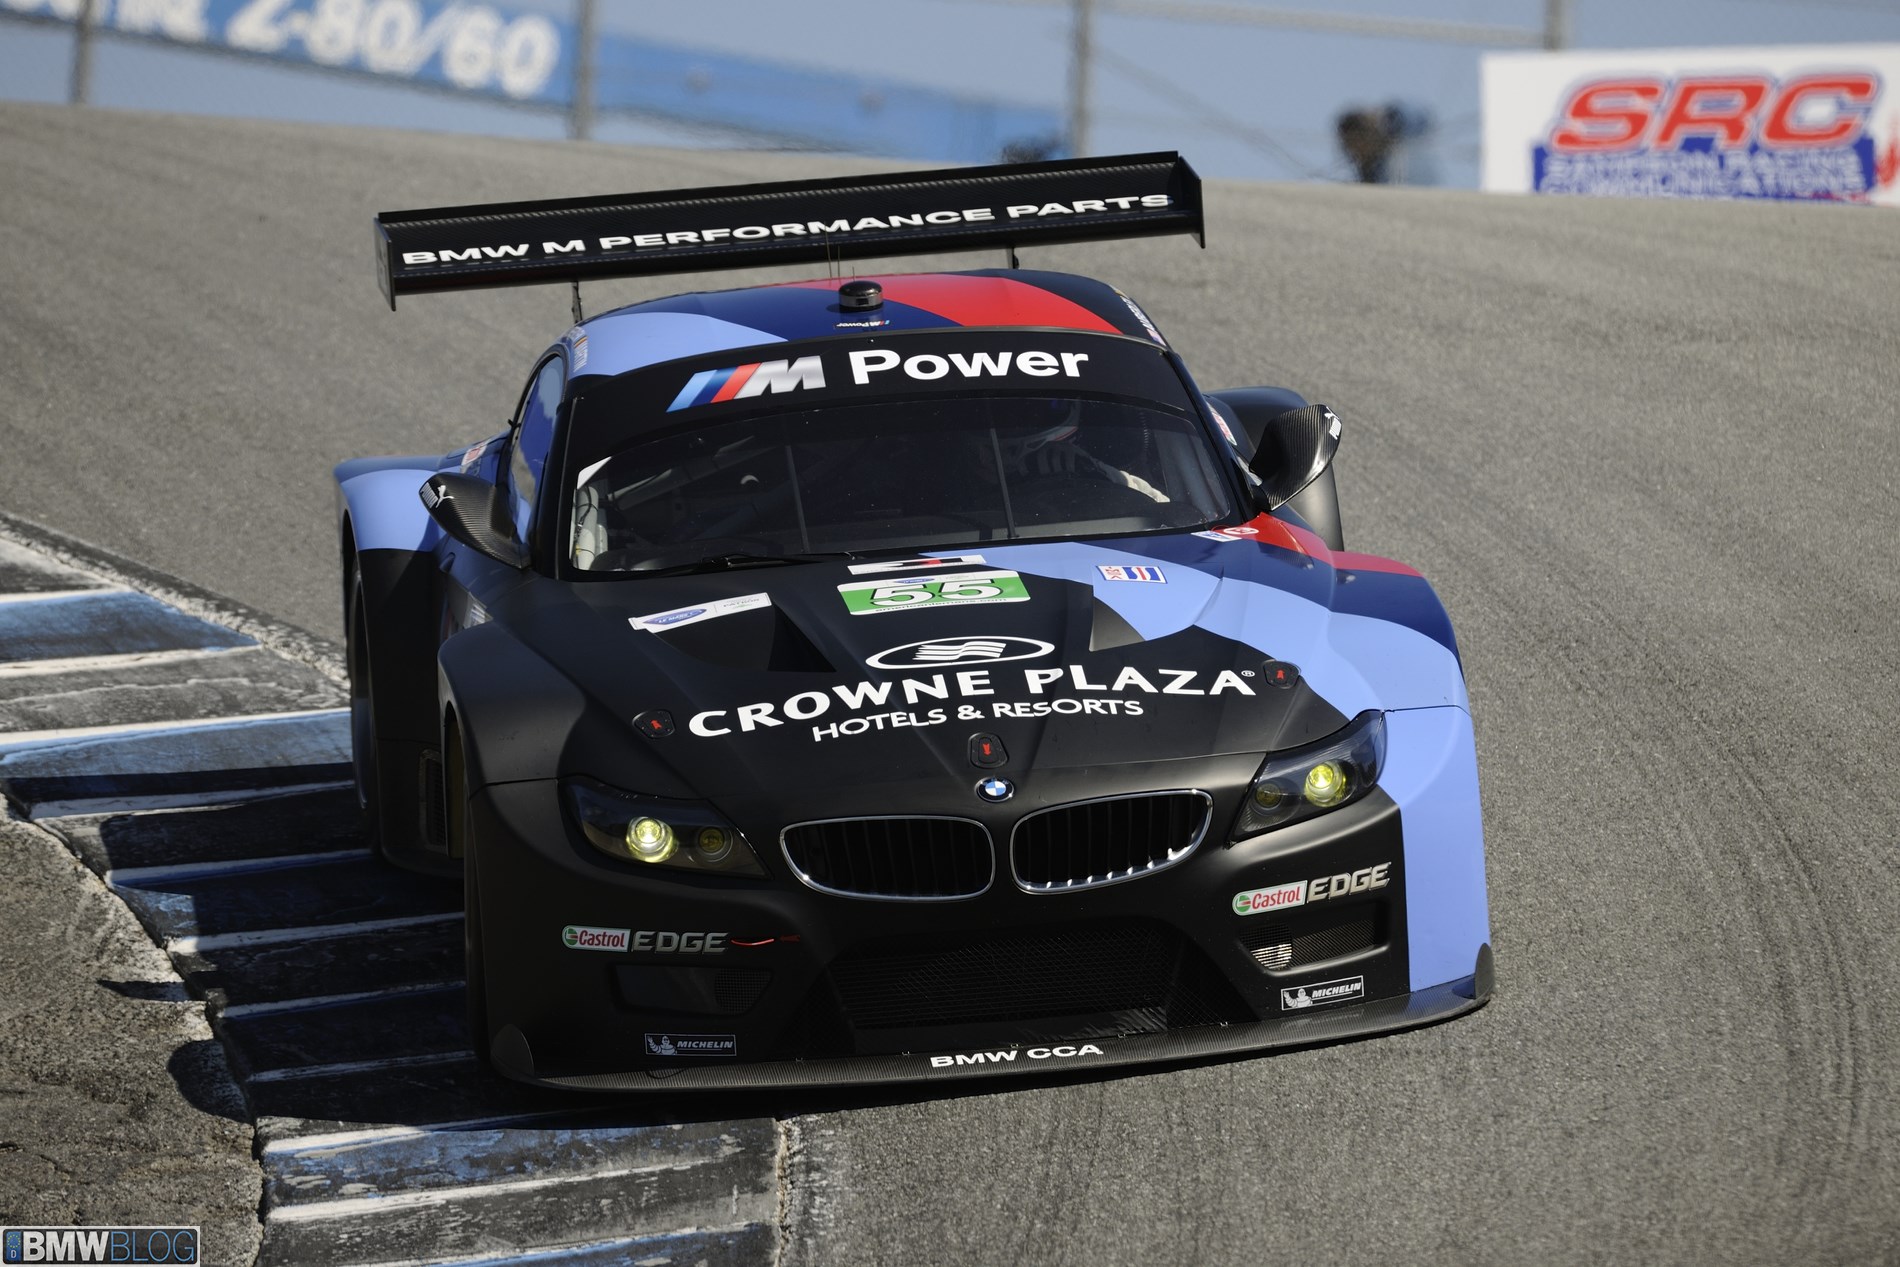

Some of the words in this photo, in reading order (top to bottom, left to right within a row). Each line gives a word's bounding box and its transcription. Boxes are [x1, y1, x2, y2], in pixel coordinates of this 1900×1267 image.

[1554, 76, 1875, 151] SRC
[403, 244, 529, 265] BMW
[542, 240, 586, 254] M
[599, 209, 996, 250] PERFORMANCE
[1007, 194, 1169, 219] PARTS
[849, 349, 1089, 385] Power
[871, 578, 1003, 606] 55
[689, 671, 995, 737] CROWNE
[813, 708, 947, 741] HOTELS
[957, 704, 984, 720] &
[992, 698, 1144, 718] RESORTS
[1251, 886, 1301, 910] Castrol
[1307, 861, 1392, 904] EDGE
[578, 930, 625, 948] Castrol
[632, 930, 729, 954] EDGE
[1311, 982, 1361, 998] MICHELIN
[676, 1040, 734, 1049] MICHELIN
[930, 1050, 1018, 1068] BMW
[1027, 1044, 1104, 1059] CCA
